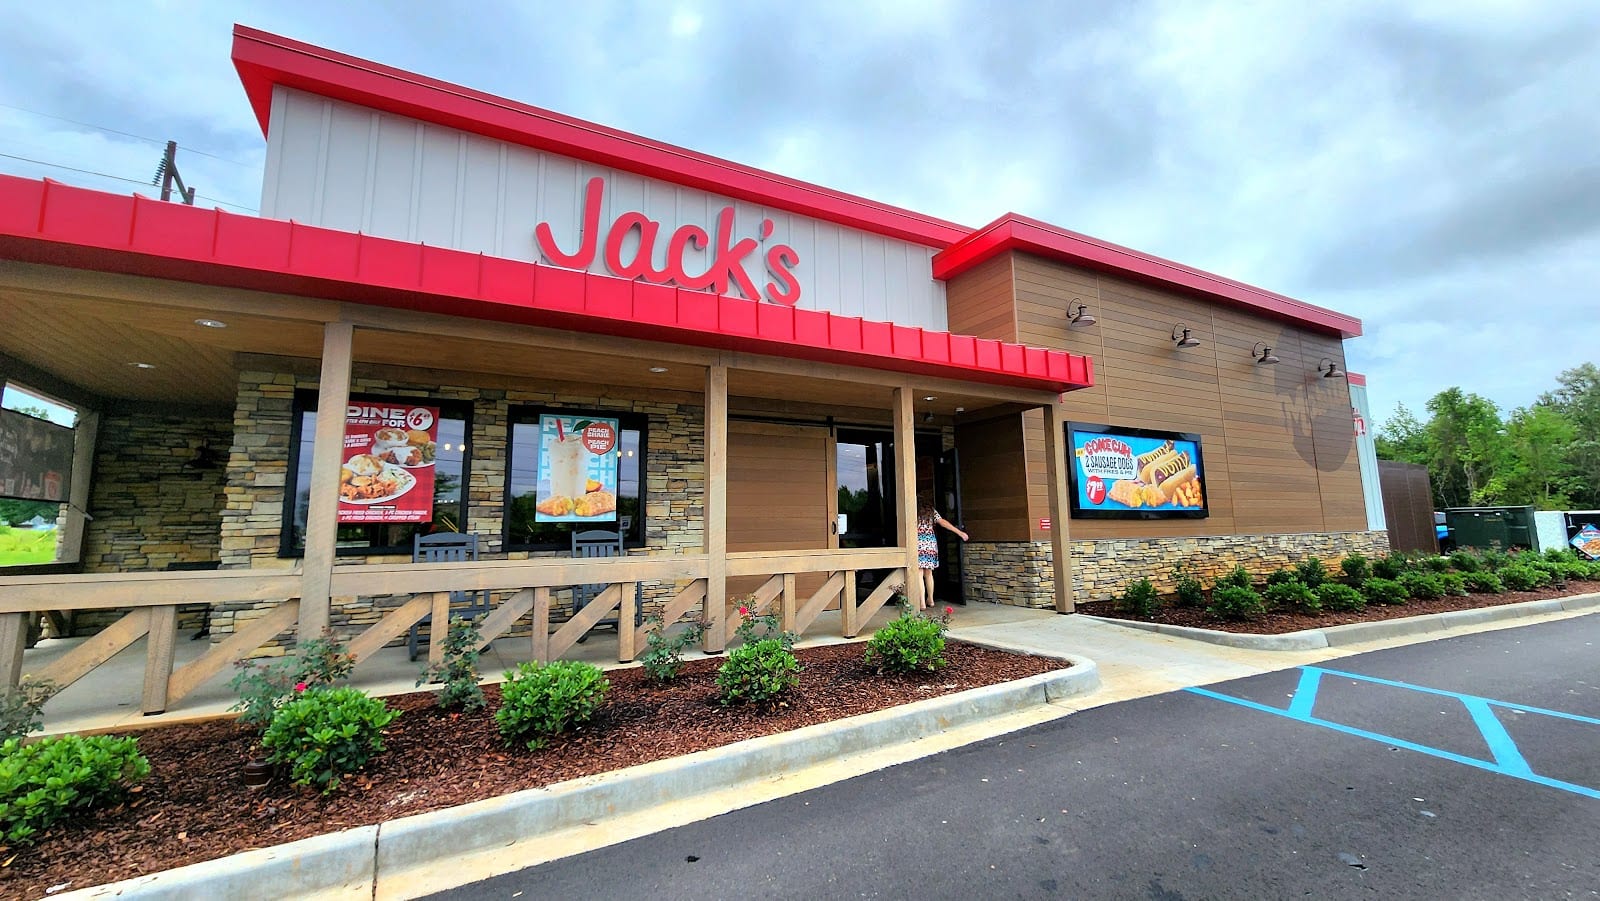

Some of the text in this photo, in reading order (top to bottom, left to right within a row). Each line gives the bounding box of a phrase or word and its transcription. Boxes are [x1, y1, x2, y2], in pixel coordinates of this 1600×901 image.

[535, 176, 801, 307] Jack's
[346, 405, 406, 420] DINE
[382, 419, 406, 428] FOR
[1085, 455, 1134, 470] 2 SAUSAGE DOGS
